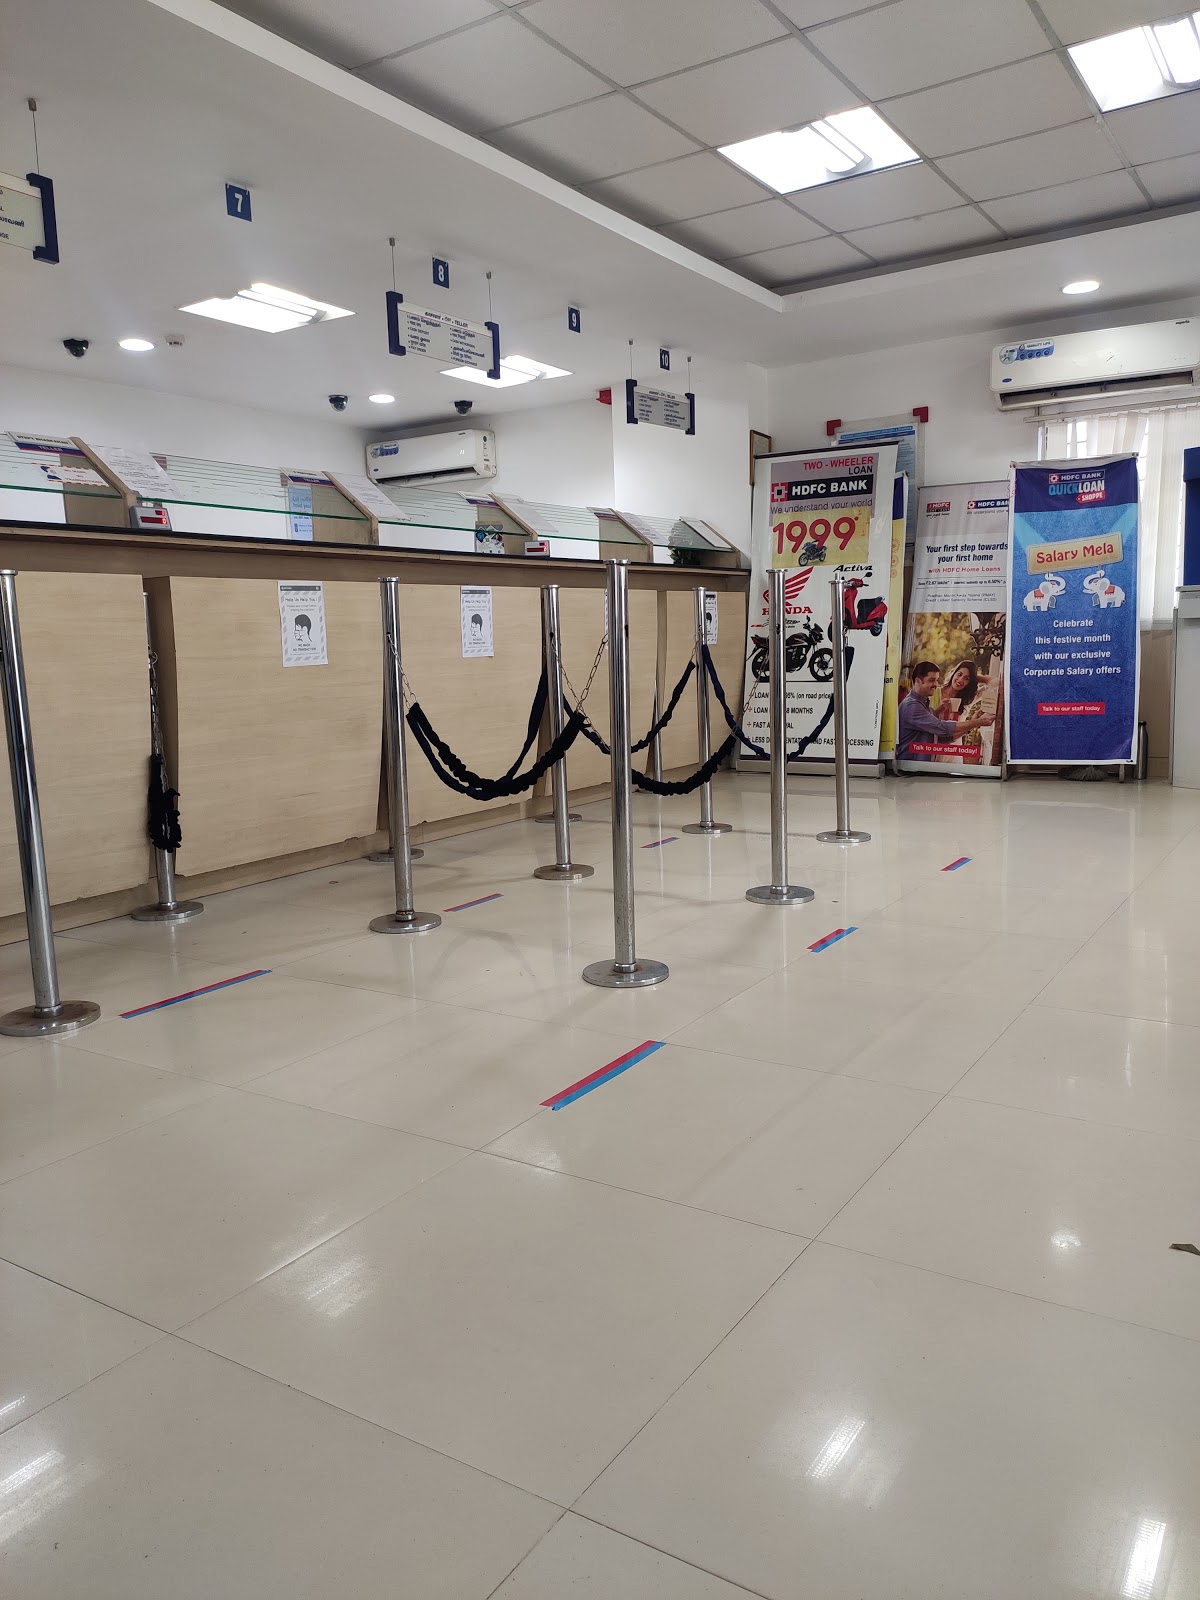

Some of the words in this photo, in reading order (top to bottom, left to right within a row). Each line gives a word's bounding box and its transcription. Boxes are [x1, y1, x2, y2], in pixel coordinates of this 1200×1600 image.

[234, 193, 243, 212] 7
[438, 265, 444, 282] 8
[571, 313, 577, 327] 9
[661, 354, 668, 367] 10
[803, 460, 823, 471] TWO
[830, 456, 874, 468] WHEELER
[848, 465, 873, 476] LOAN
[792, 483, 826, 496] HDFC
[830, 479, 868, 493] BANK
[1048, 480, 1105, 496] QUICKLOAN
[1081, 492, 1103, 501] SHOPPE
[770, 506, 783, 515] We
[784, 501, 829, 514] understand
[850, 498, 873, 508] world
[926, 545, 942, 554] Your
[943, 544, 958, 552] first
[961, 543, 976, 553] step
[978, 542, 1008, 551] towards
[1036, 550, 1078, 563] Salary
[1083, 542, 1113, 557] Mela
[937, 556, 954, 565] your
[955, 554, 970, 562] first
[972, 553, 994, 561] home
[832, 564, 873, 573] Activa
[762, 606, 813, 616] HNDA
[1053, 619, 1093, 628] Celebrate
[1035, 636, 1051, 644] this
[1053, 635, 1082, 644] festive
[1084, 633, 1111, 643] month
[1034, 652, 1052, 660] with
[1071, 650, 1111, 659] exclusive
[1024, 668, 1065, 677] Corporate
[1067, 667, 1093, 676] Salary
[1096, 666, 1121, 674] offers
[796, 692, 805, 700] (on
[752, 721, 766, 729] FAST
[958, 747, 978, 755] today!
